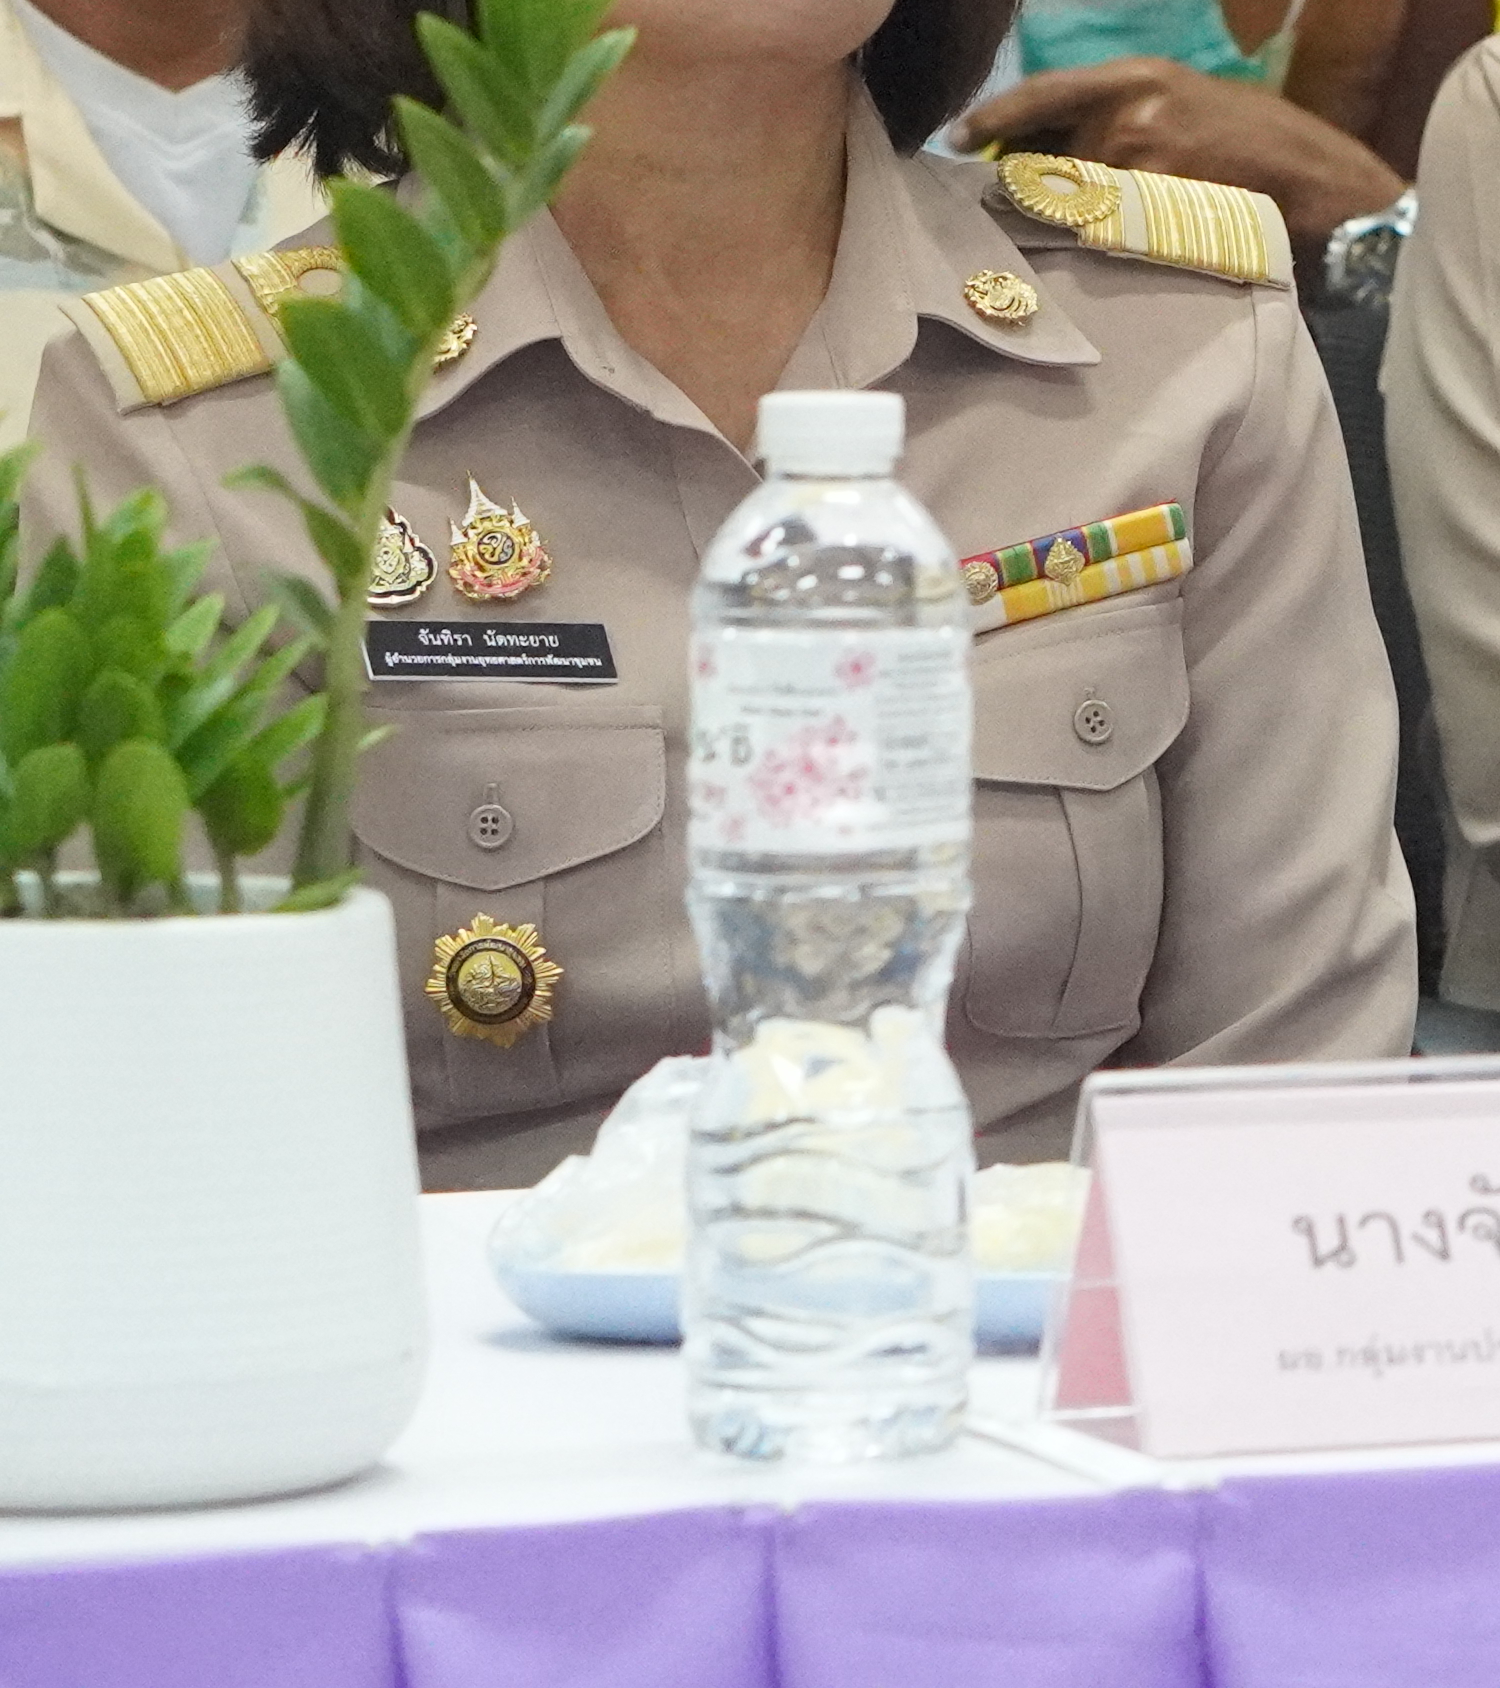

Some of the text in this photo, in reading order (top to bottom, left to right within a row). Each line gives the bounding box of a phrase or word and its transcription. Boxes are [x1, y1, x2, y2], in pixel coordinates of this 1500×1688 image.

[417, 627, 560, 648] จันทิรา นัดทะยาย
